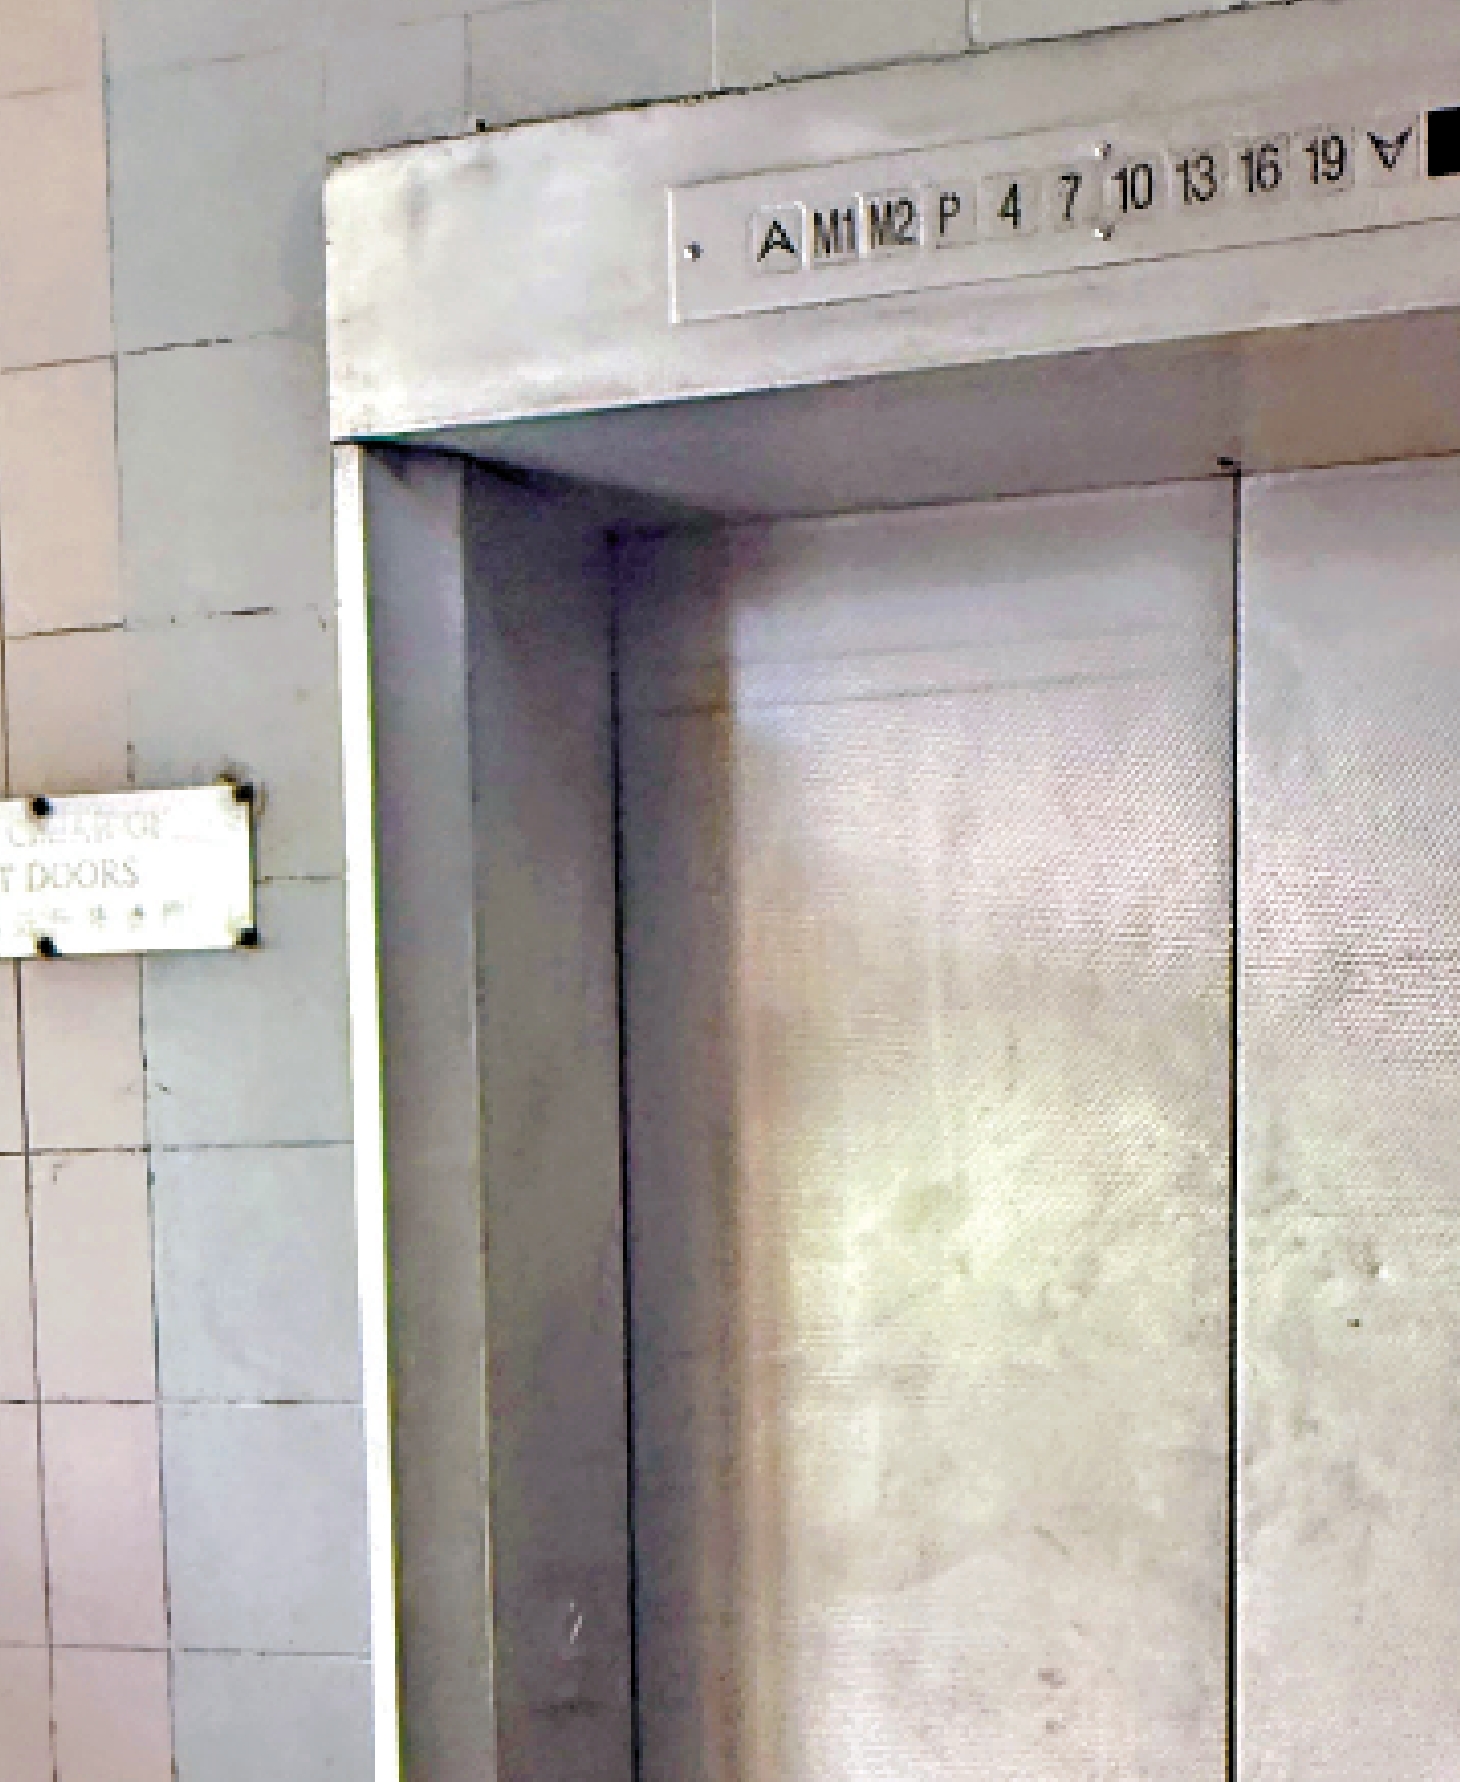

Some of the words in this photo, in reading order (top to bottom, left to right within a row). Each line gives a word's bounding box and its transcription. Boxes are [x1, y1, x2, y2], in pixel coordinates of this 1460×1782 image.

[813, 208, 856, 255] M1
[870, 196, 917, 248] M2
[939, 191, 961, 235] P
[996, 183, 1022, 230] 4
[1061, 172, 1083, 221] 7
[1111, 163, 1153, 213] 10
[1176, 153, 1219, 204] 13
[1241, 143, 1284, 194] 16
[1305, 135, 1348, 185] 19
[25, 856, 140, 892] DOORS
